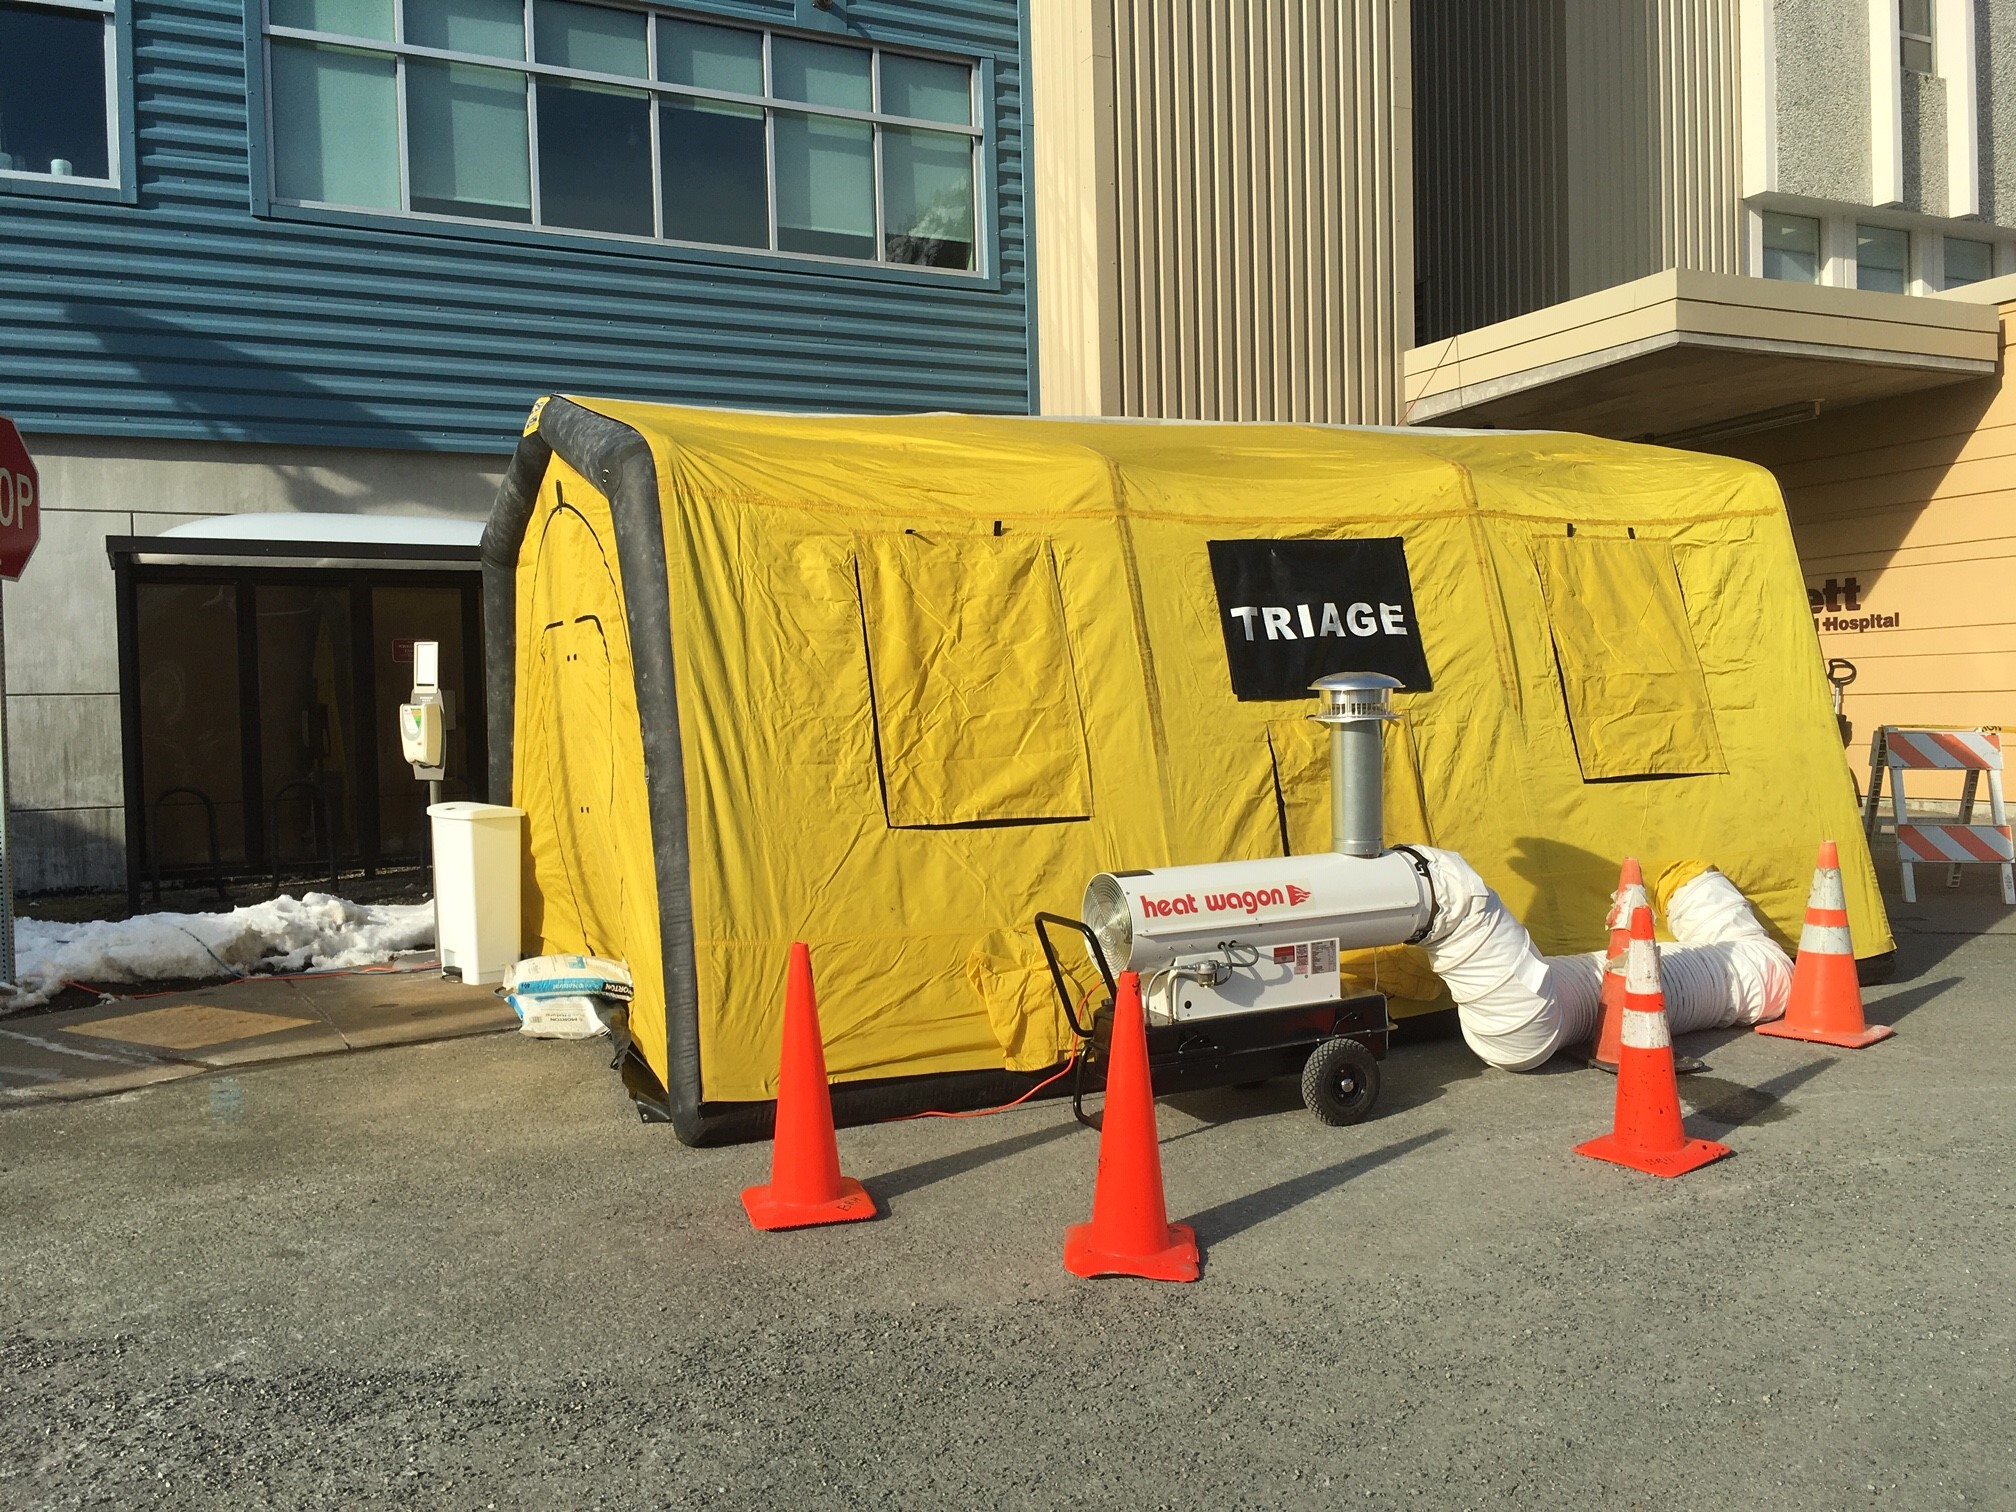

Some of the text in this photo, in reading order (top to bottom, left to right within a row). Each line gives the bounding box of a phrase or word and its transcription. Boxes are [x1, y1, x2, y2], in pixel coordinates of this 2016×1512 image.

[1230, 602, 1408, 642] TRIAGE
[1823, 612, 1899, 633] Hospital
[1140, 887, 1284, 918] heat wagon
